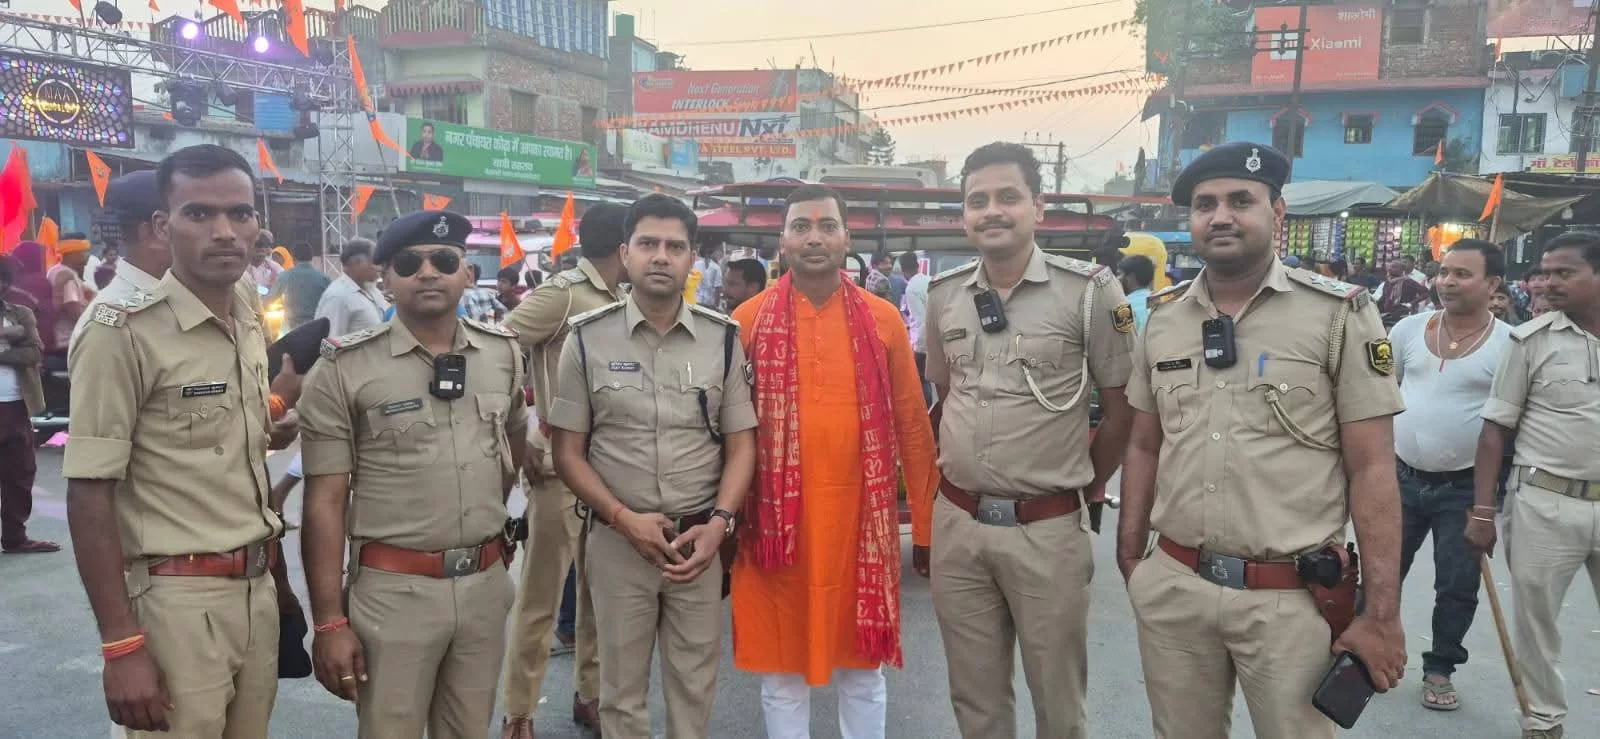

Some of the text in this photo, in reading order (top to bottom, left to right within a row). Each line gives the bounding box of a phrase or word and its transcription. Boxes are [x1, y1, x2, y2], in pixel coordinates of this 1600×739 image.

[1310, 36, 1362, 50] Xiaomi
[688, 82, 761, 95] Next Generation
[444, 131, 465, 146] नगर
[466, 130, 492, 150] पंचायत
